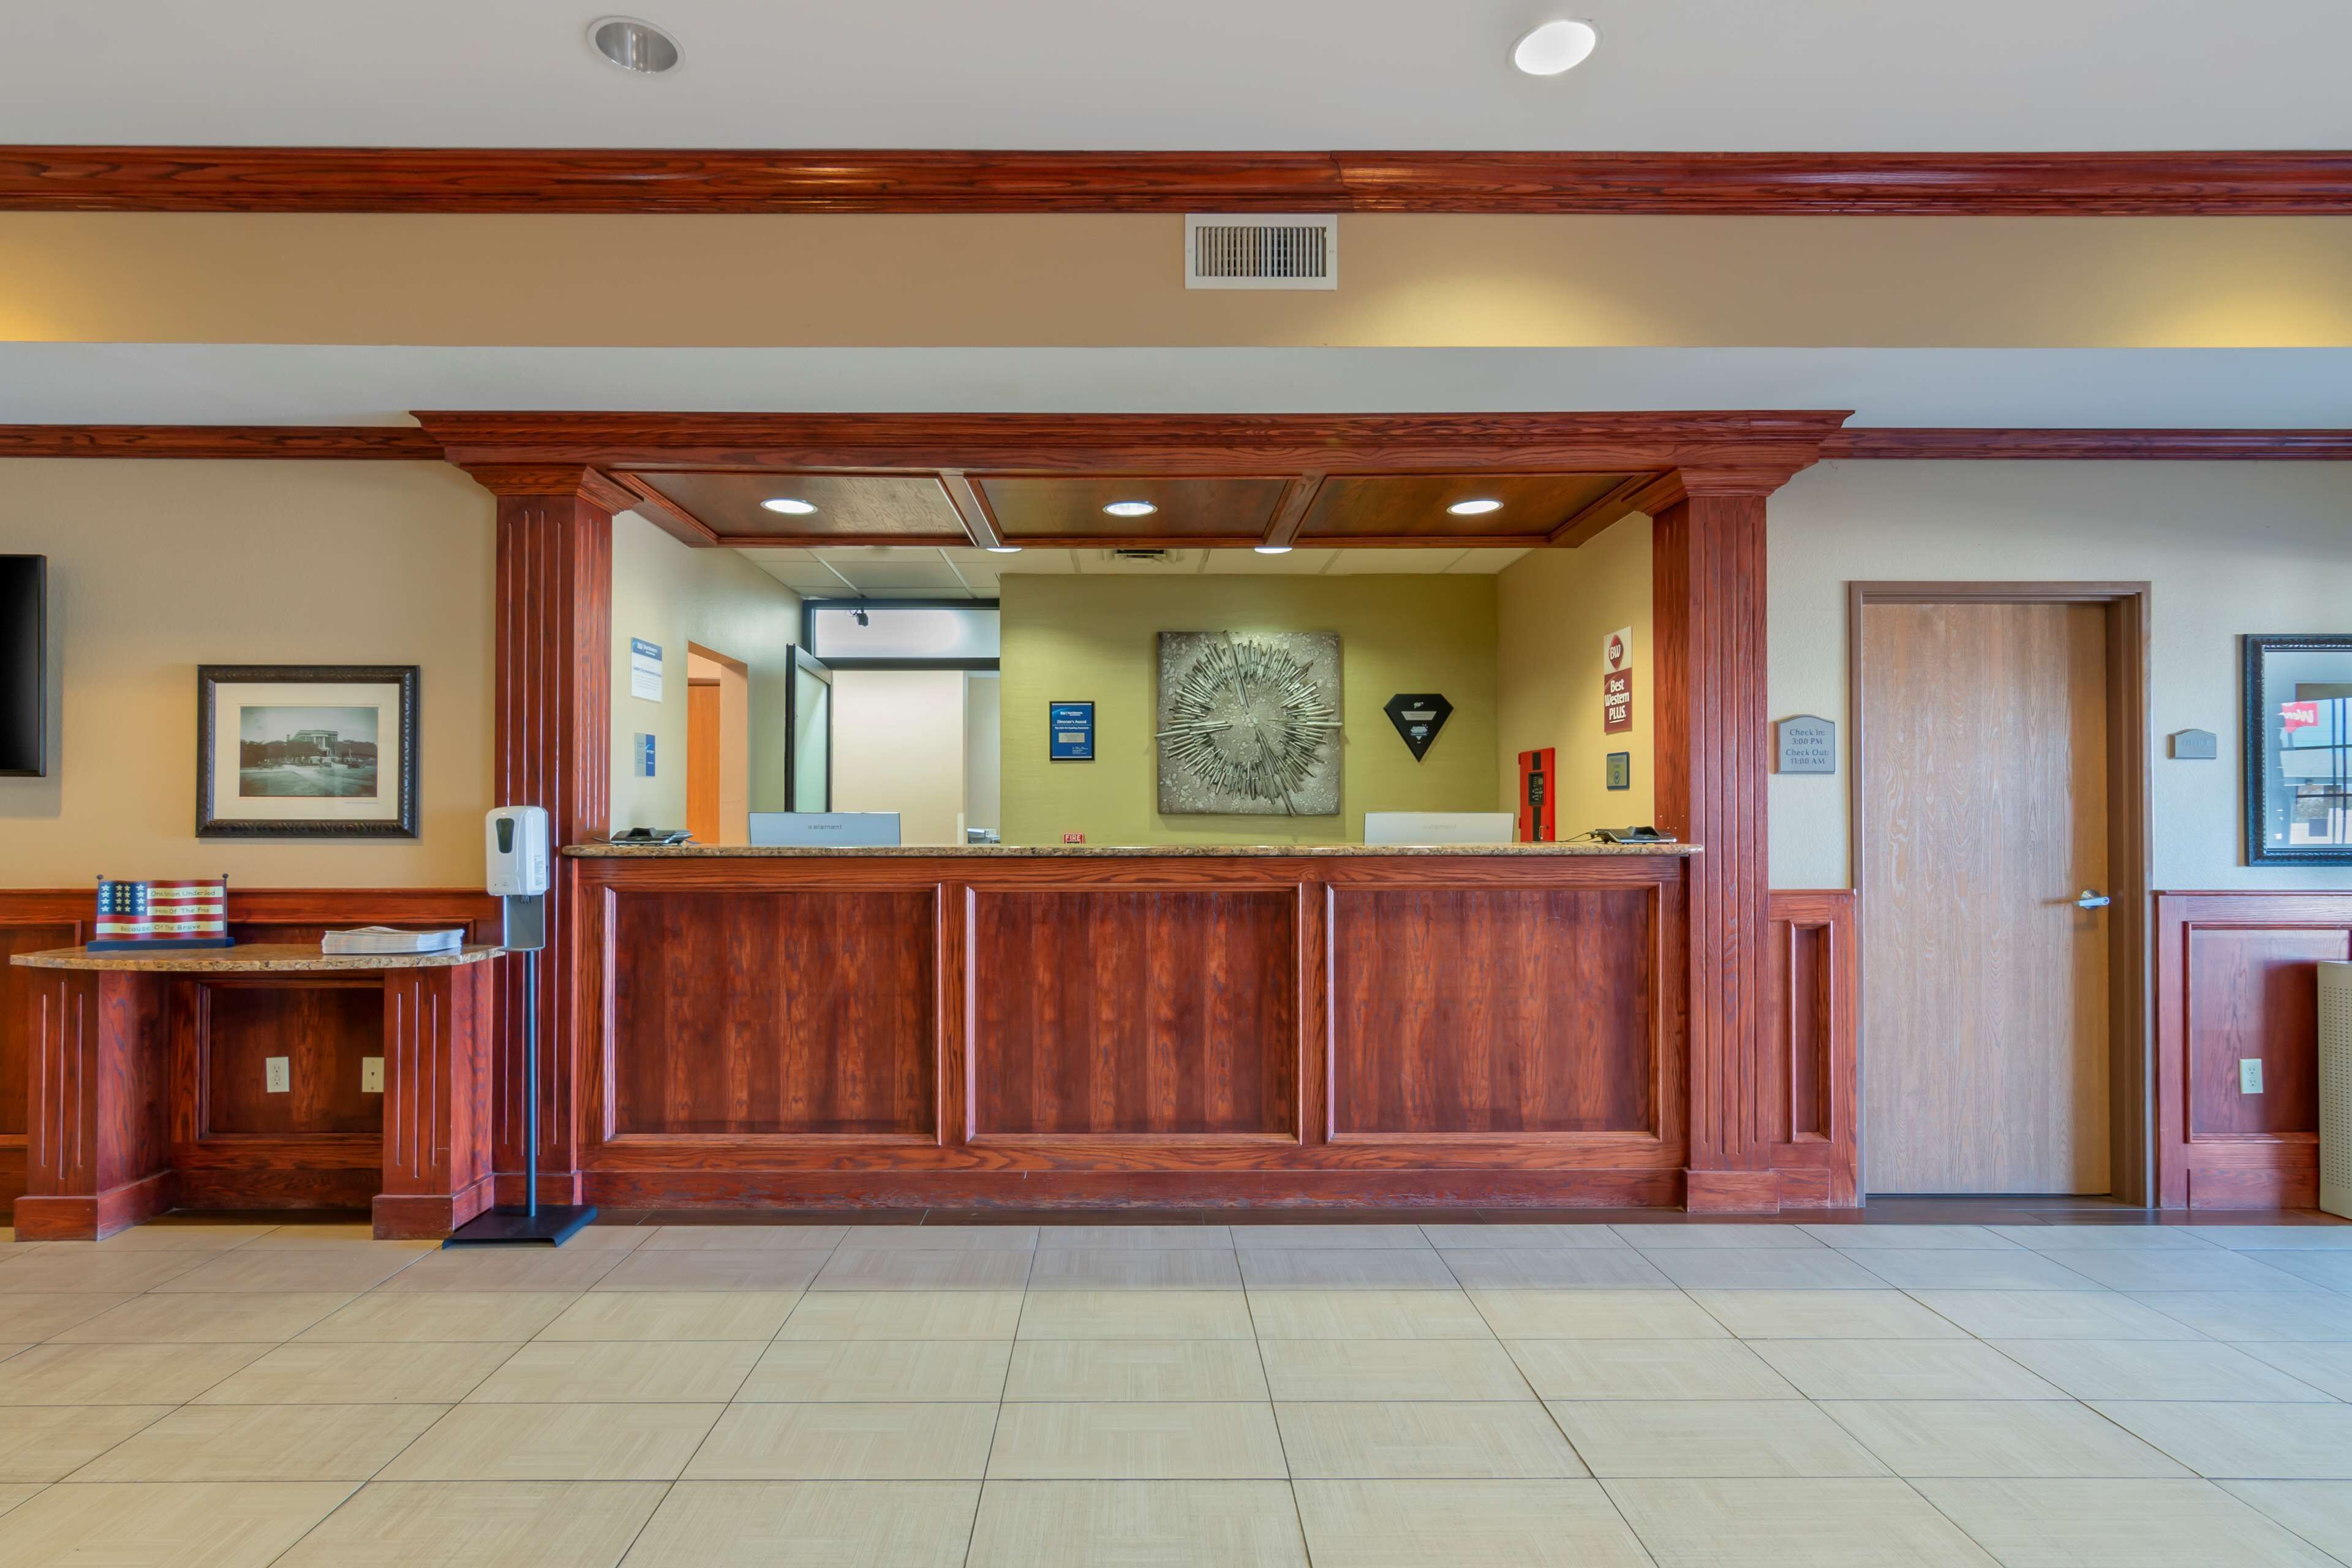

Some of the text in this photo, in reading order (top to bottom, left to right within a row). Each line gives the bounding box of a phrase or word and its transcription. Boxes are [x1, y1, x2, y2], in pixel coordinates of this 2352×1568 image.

[1610, 644, 1621, 660] BW
[1610, 679, 1624, 693] Best
[1605, 692, 1629, 706] Western
[1609, 705, 1625, 720] PLUS
